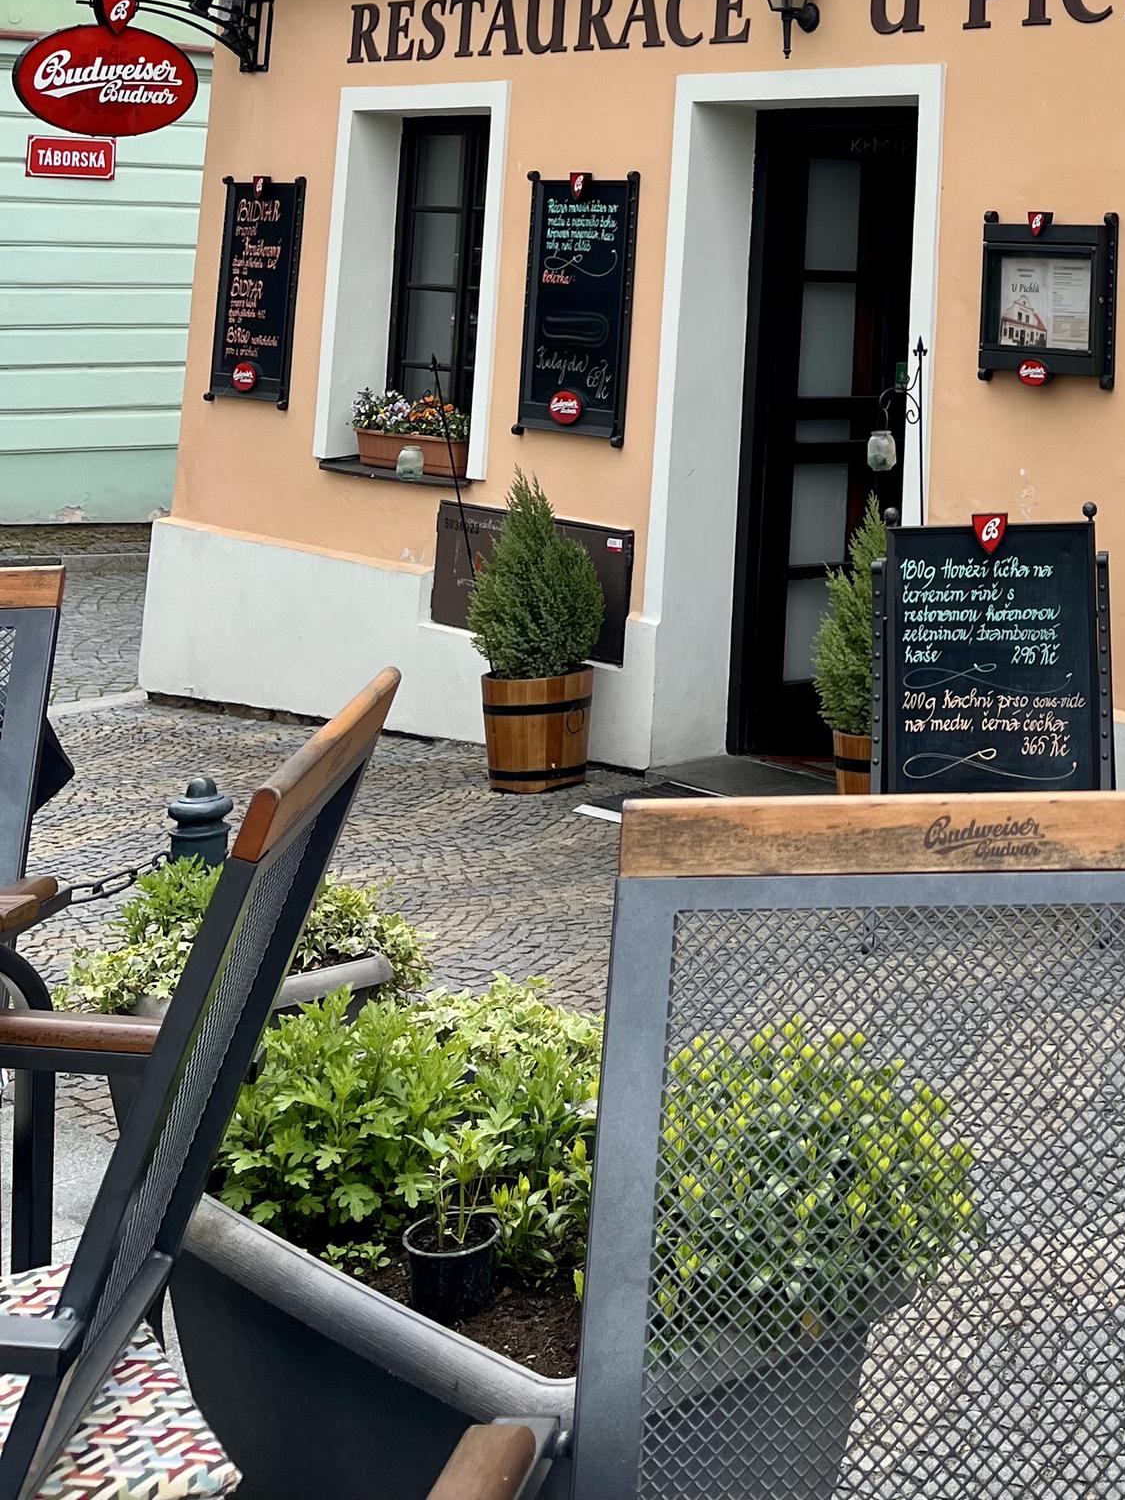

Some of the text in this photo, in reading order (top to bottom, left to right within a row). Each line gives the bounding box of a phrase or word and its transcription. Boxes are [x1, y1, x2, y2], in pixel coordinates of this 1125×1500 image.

[33, 49, 183, 90] Budweiser
[98, 79, 177, 105] Budvar
[37, 147, 106, 168] TÁBORSKÁ
[900, 555, 1054, 590] 180g Hovězí líčka na
[902, 581, 1015, 603] červeném víně s
[902, 623, 1061, 646] zeleninou, bramborová
[904, 643, 1061, 666] kaše 295 Kč
[901, 687, 1087, 723] 200g Kachní prso sous-vide
[904, 709, 1069, 734] na medu, černá čočka
[1021, 733, 1071, 757] 365 Kč
[924, 815, 1044, 850] Budweiser
[975, 840, 1041, 860] Budvar
